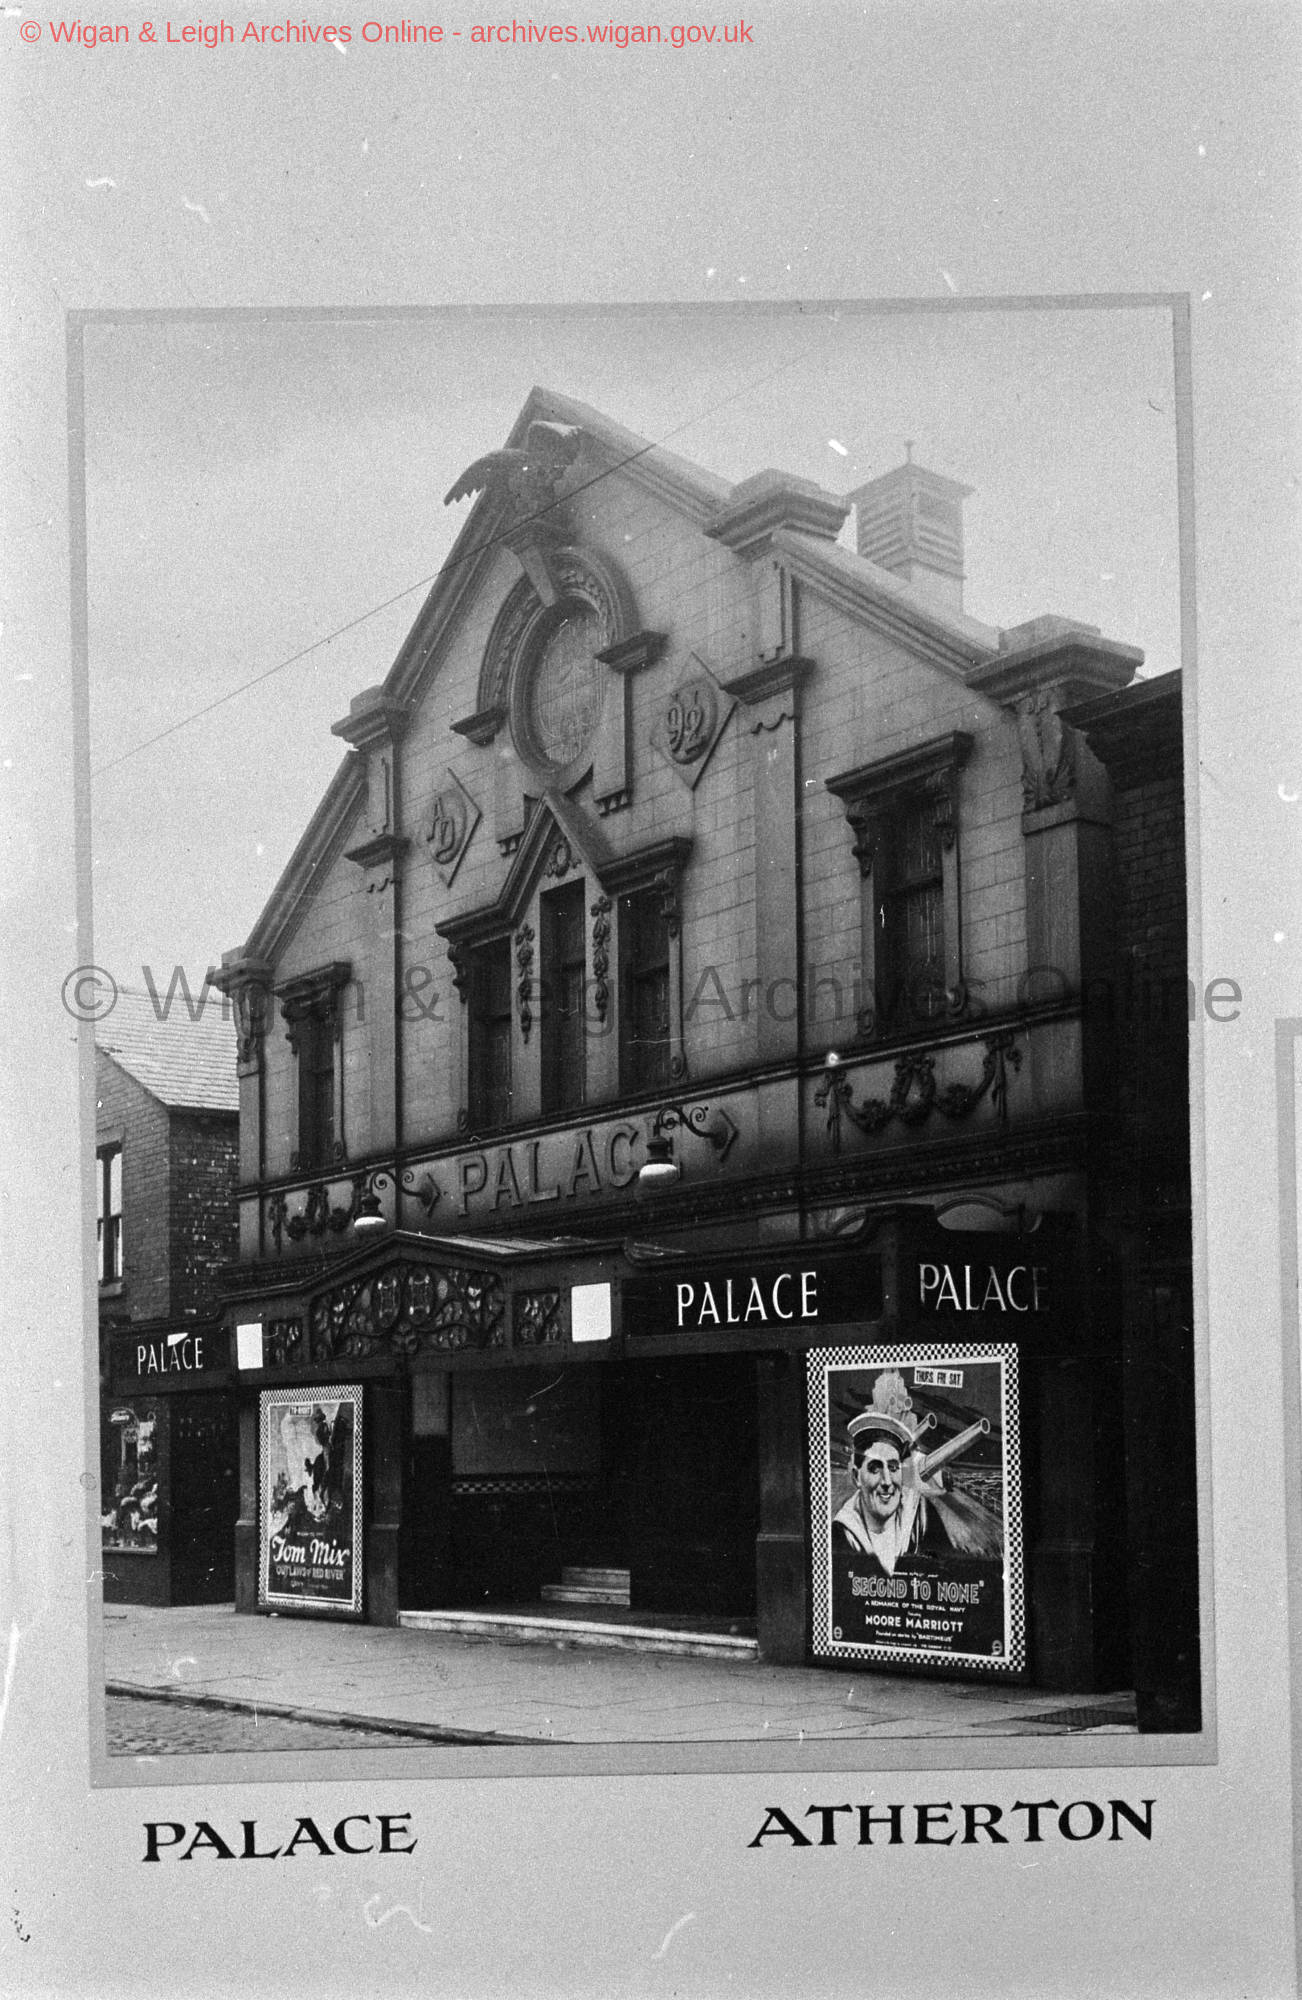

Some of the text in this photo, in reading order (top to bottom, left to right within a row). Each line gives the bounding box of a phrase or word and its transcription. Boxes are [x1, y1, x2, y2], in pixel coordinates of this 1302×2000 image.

[456, 1121, 682, 1217] PALAC
[676, 1271, 819, 1327] PALACE
[137, 1337, 204, 1376] PALACE
[271, 1535, 351, 1566] Tom Mix
[871, 1600, 899, 1608] ROMANCE
[926, 1604, 947, 1613] ROYAL
[910, 1577, 931, 1601] TO
[865, 1614, 964, 1633] MOORE MARRIOTT
[142, 1799, 1157, 1862] PALACE ATHERTON
